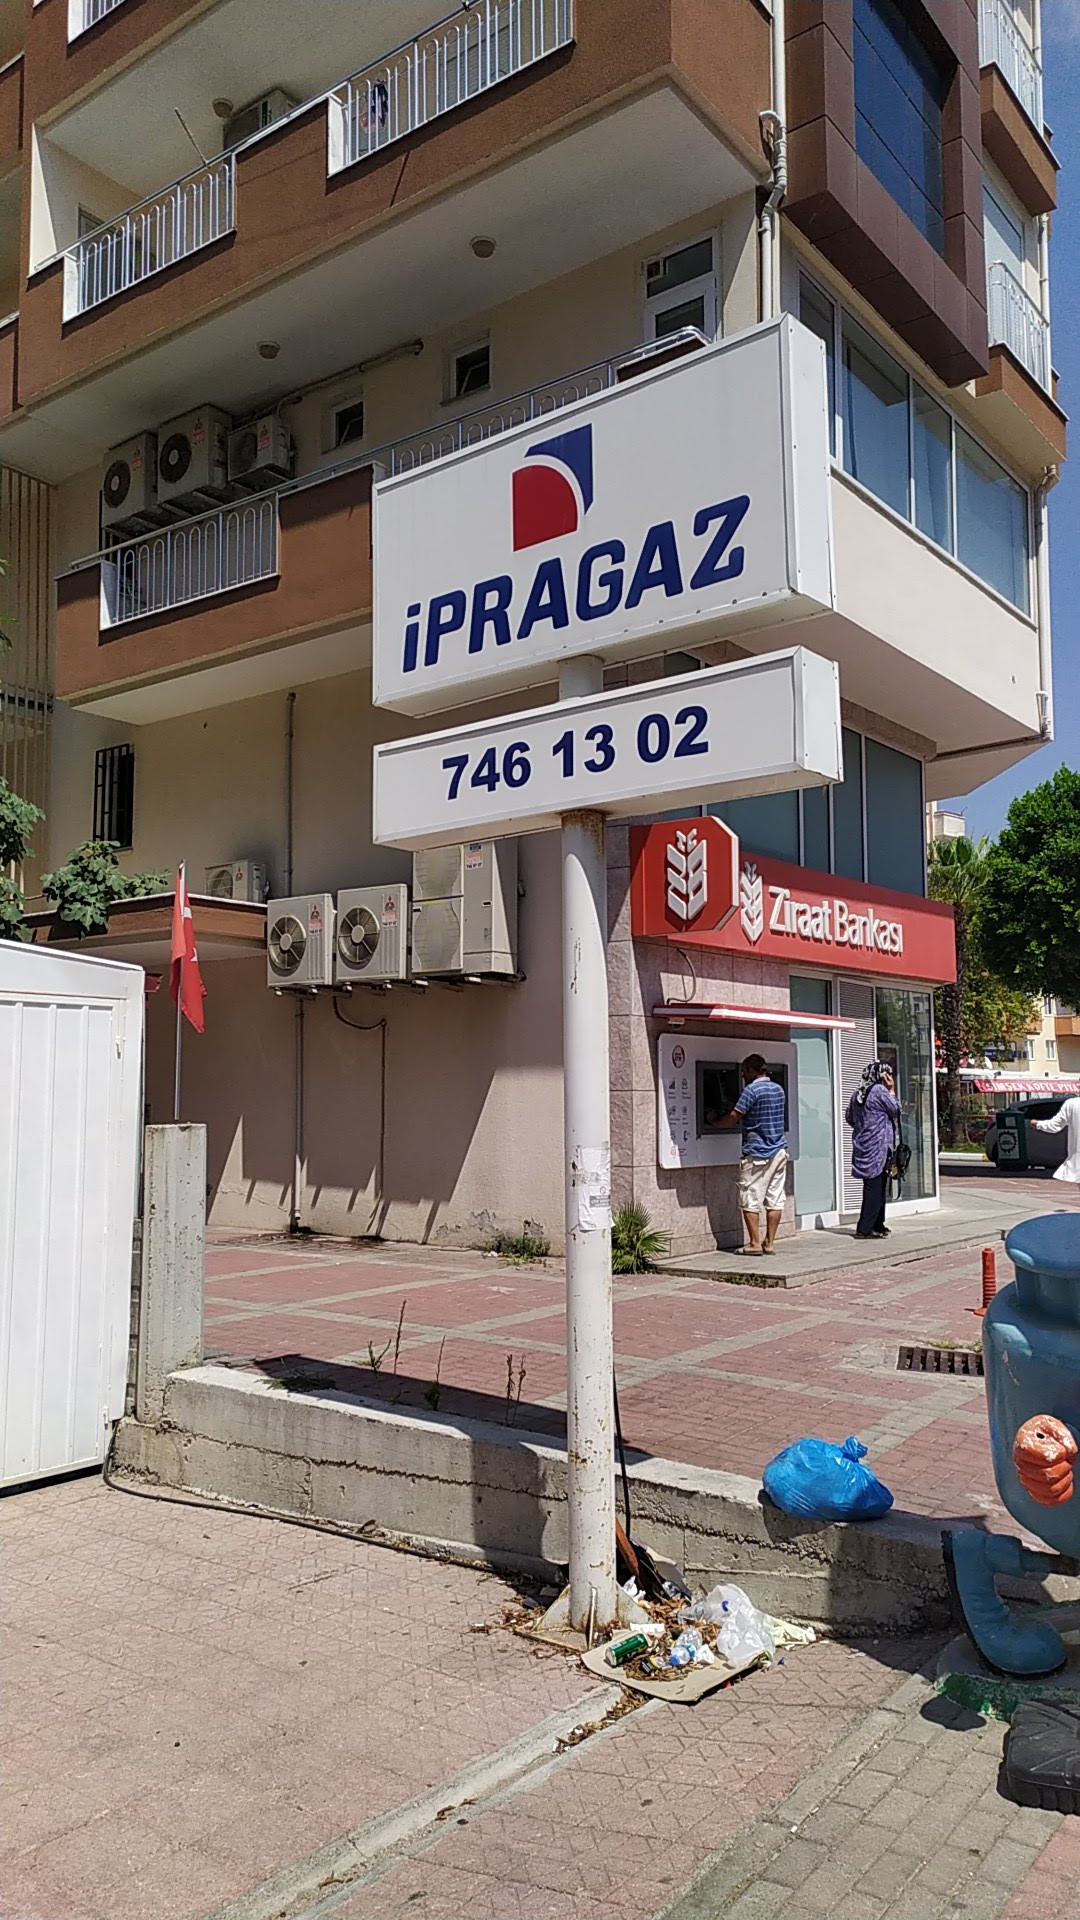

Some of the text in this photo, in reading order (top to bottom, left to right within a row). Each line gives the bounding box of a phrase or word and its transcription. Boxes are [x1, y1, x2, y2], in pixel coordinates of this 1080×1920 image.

[442, 705, 709, 801] 746 13 02
[768, 886, 904, 952] Ziraat Bankası
